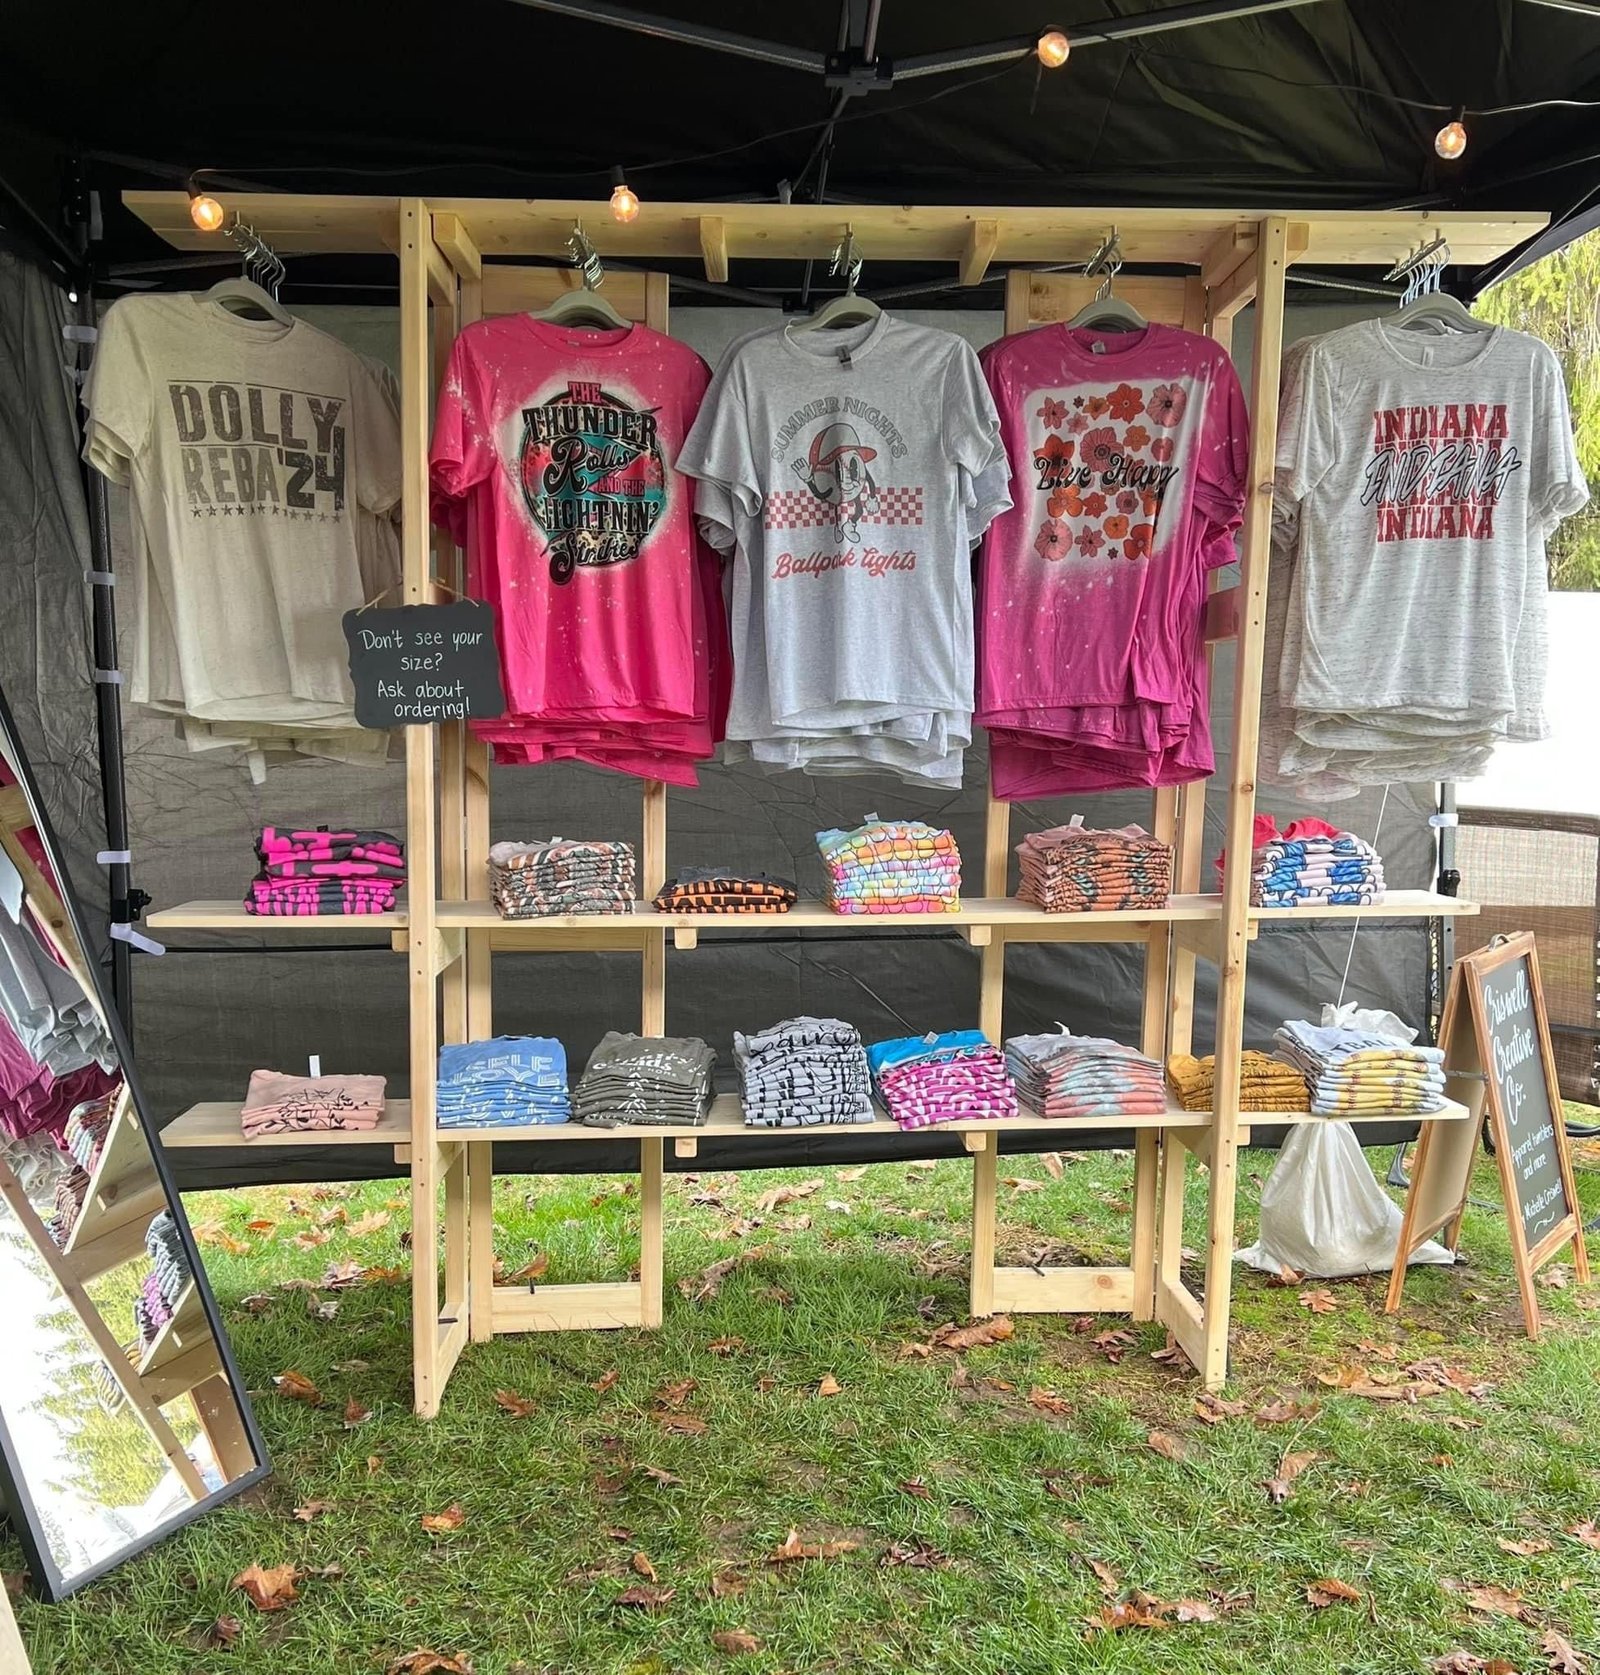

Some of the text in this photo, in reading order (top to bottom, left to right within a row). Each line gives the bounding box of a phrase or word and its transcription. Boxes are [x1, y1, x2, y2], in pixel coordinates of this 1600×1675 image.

[569, 382, 601, 403] THE
[168, 384, 343, 452] DOLLY
[522, 405, 659, 450] THUNDER
[771, 396, 908, 463] SUMMER NIGHTS
[1374, 404, 1508, 441] INDIANA
[180, 446, 281, 506] REBA
[542, 435, 632, 496] Rolls
[1034, 457, 1093, 490] Live
[1360, 444, 1523, 507] INDIANA
[594, 479, 645, 497] AND THE
[1376, 507, 1495, 542] INDIANA
[549, 530, 644, 585] Strikes
[357, 629, 483, 651] Don't see your
[400, 652, 443, 671] size?
[377, 679, 465, 698] Ask about
[394, 696, 471, 720] ordering!
[1484, 969, 1529, 1037] Criswell
[1493, 1024, 1535, 1085] Creative
[1506, 1074, 1527, 1127] Co.
[1533, 1152, 1548, 1172] more
